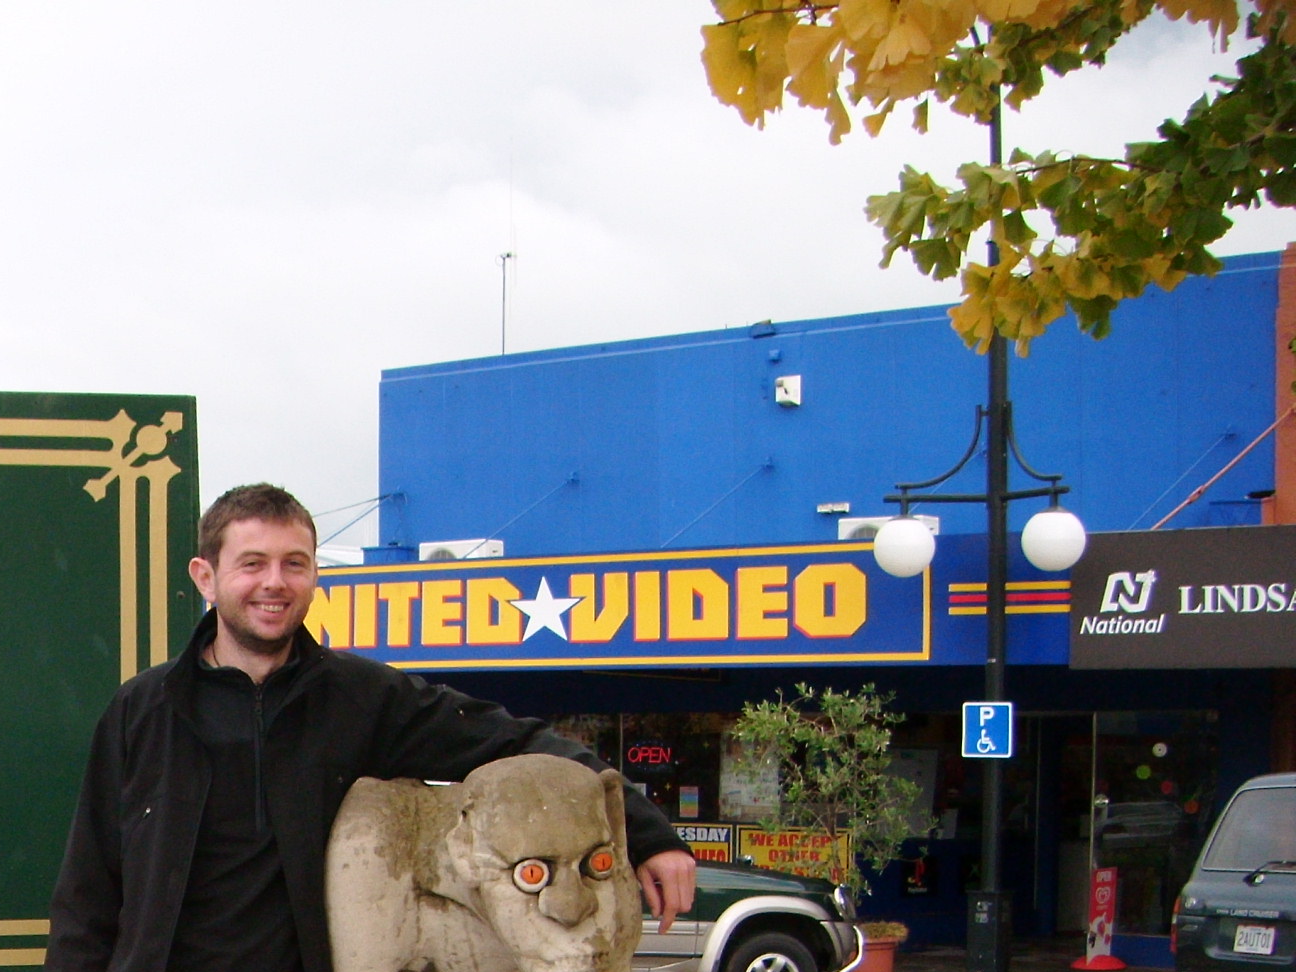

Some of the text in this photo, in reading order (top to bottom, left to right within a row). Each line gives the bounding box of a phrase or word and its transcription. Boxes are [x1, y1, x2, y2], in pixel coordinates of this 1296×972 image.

[303, 563, 867, 649] NITED VIDEO
[1178, 583, 1296, 614] LINDS
[1079, 613, 1165, 634] National
[979, 706, 995, 727] P
[627, 746, 672, 764] OPEN
[675, 826, 730, 843] ESDAY
